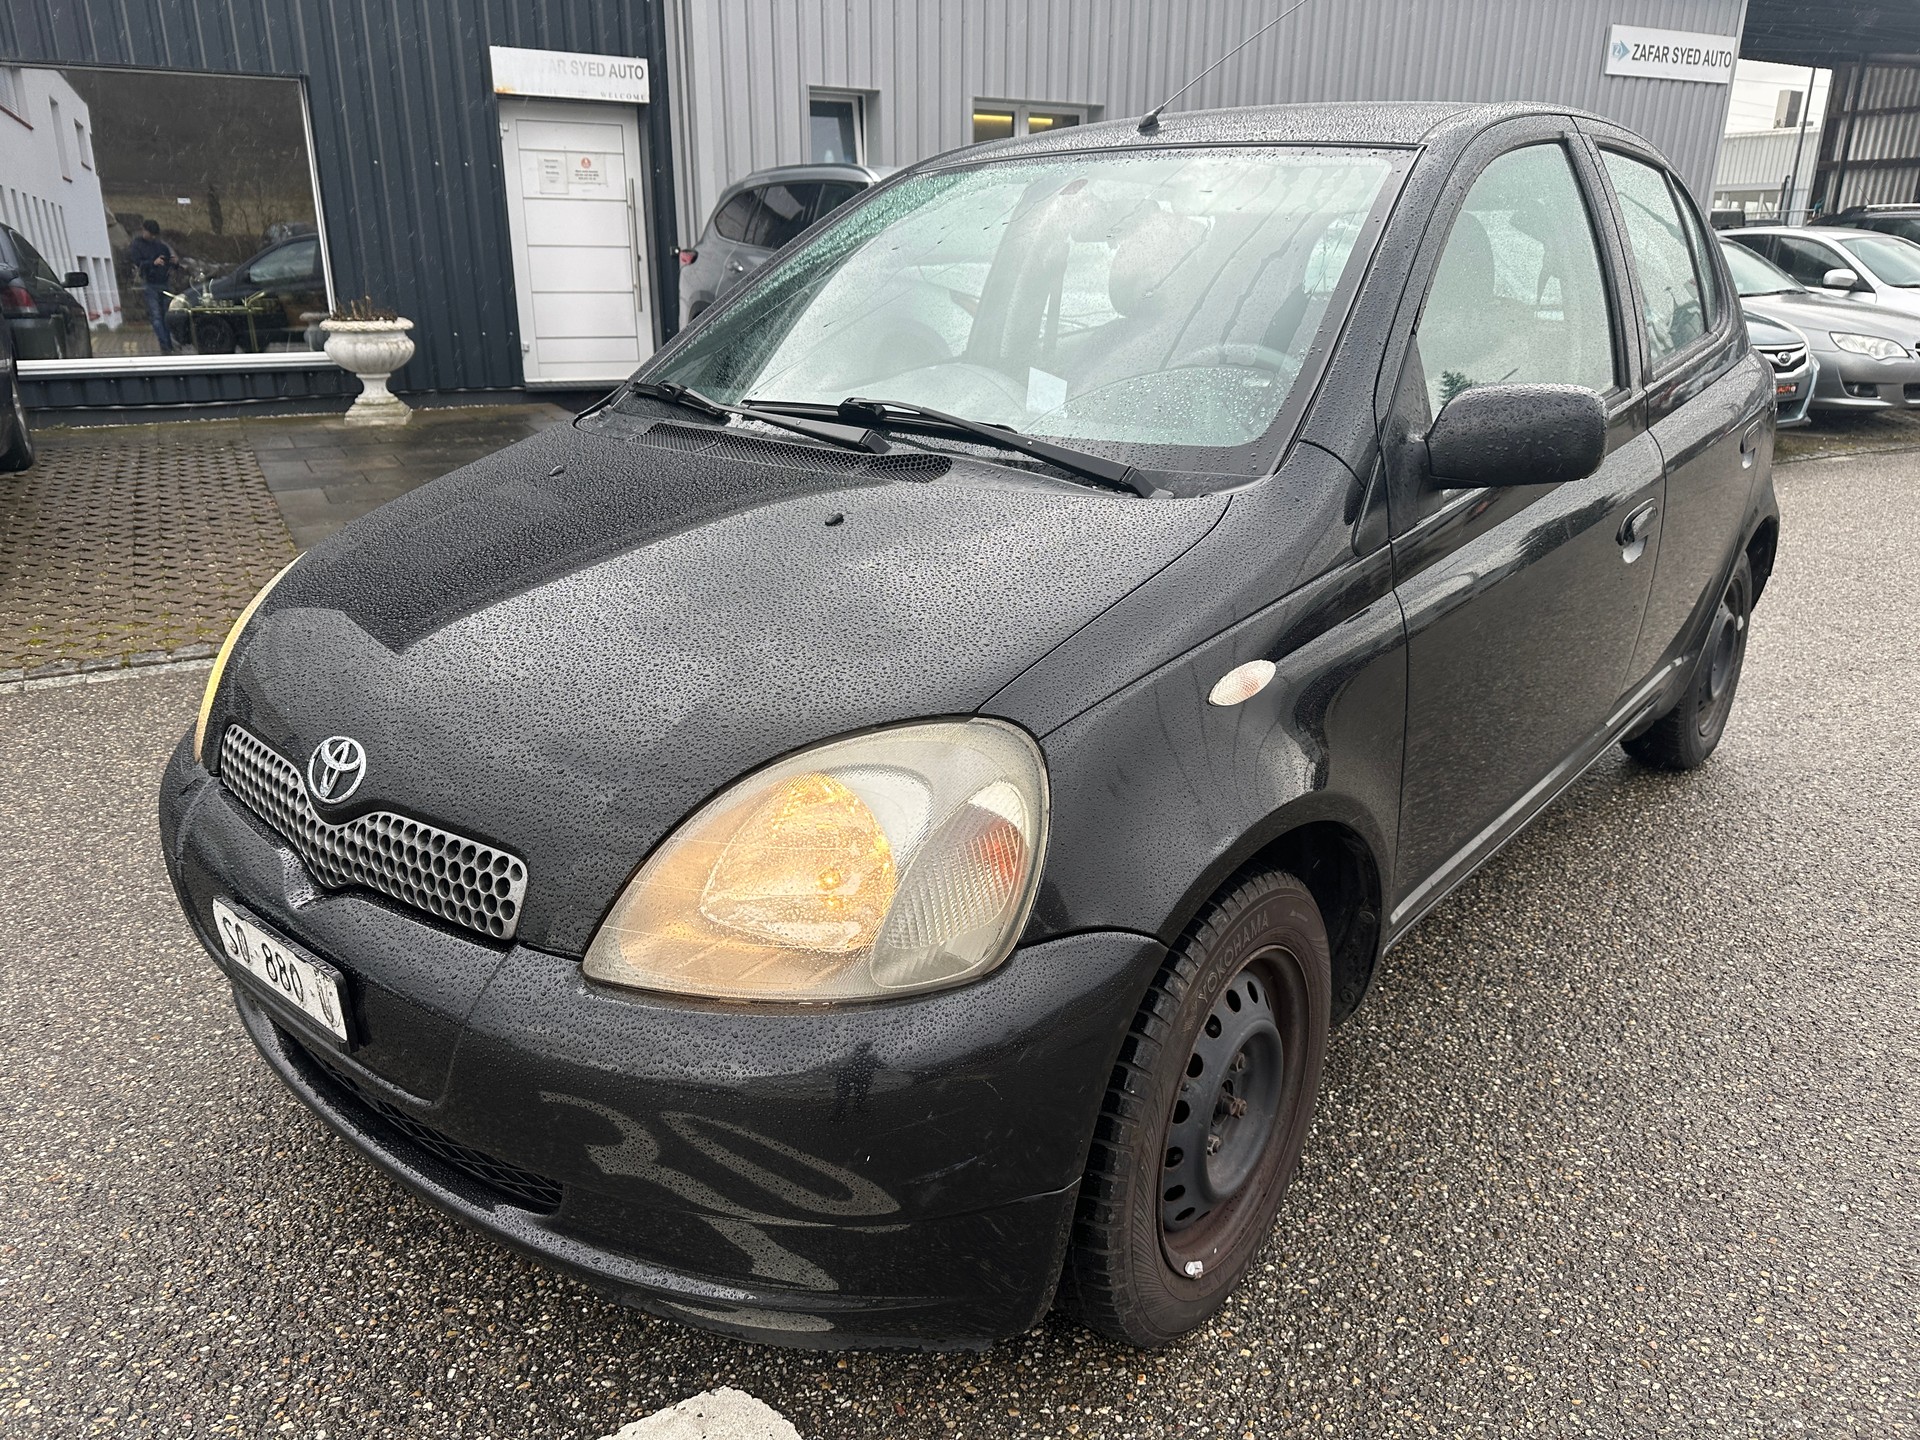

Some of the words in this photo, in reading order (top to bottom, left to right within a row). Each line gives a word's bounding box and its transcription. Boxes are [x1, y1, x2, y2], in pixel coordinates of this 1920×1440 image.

[571, 60, 606, 78] SYED
[609, 65, 644, 80] AUTO
[1632, 44, 1669, 63] ZAFAR
[1672, 47, 1701, 65] SYED
[1702, 49, 1732, 68] AUTO
[261, 942, 304, 1003] 880
[1198, 909, 1269, 1003] YOKOHAMA
